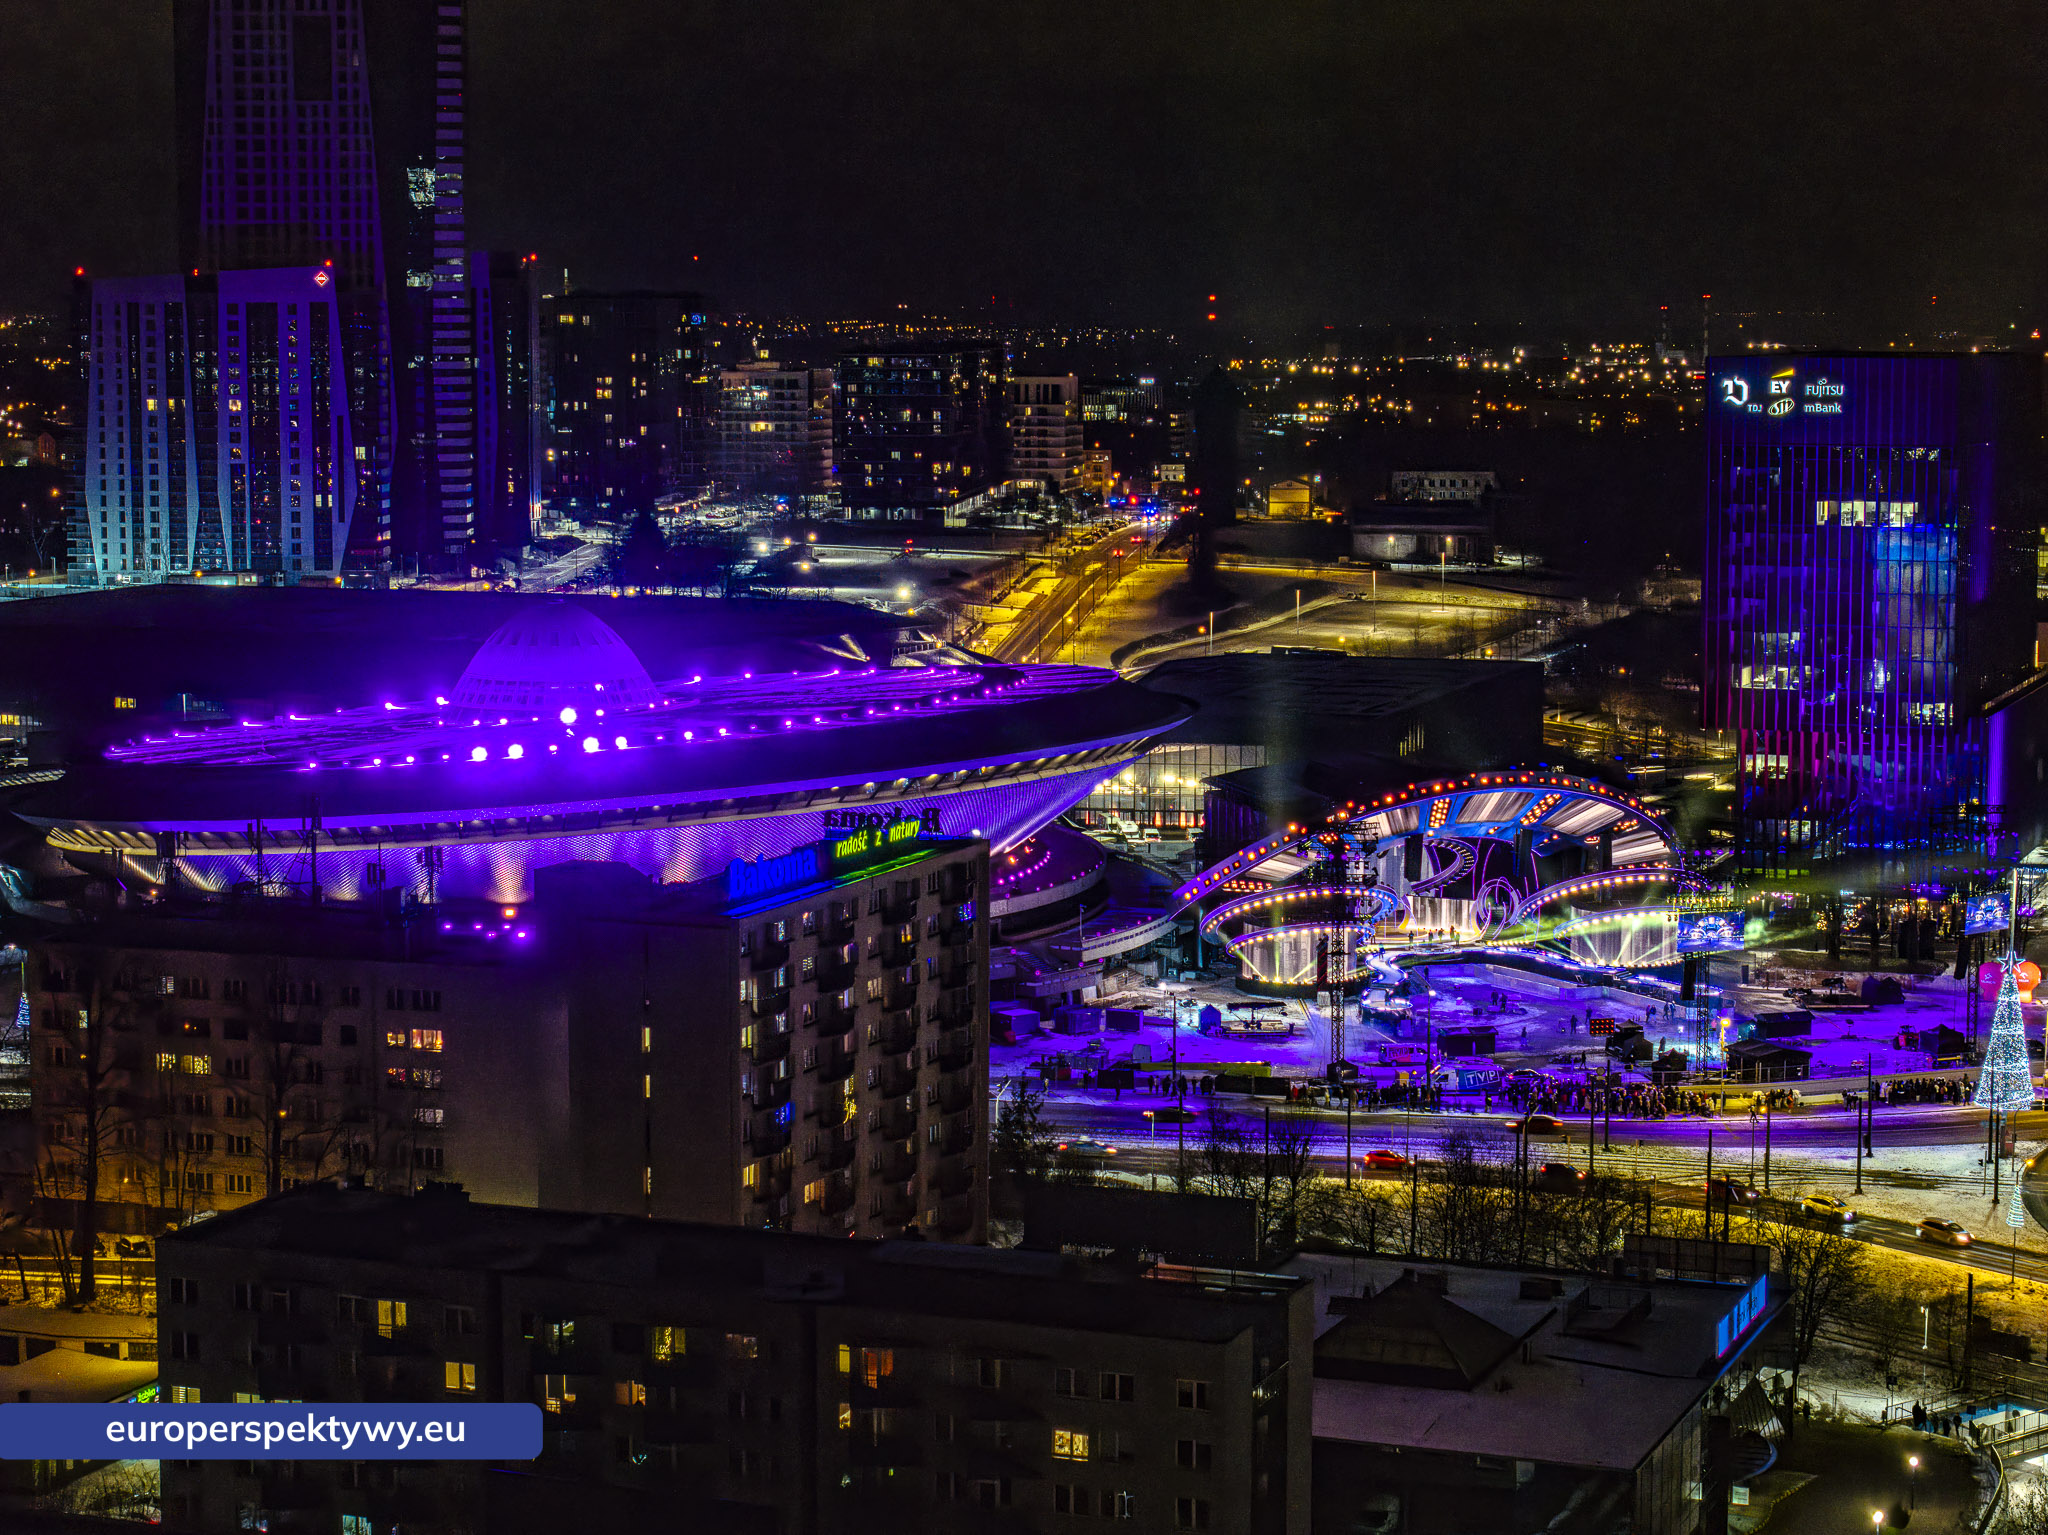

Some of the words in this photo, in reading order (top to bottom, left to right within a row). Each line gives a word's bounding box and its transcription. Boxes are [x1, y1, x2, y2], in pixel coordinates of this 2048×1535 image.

[1770, 380, 1790, 394] EY
[1805, 381, 1845, 398] FUJITSU
[1747, 404, 1763, 413] TDJ
[1804, 403, 1842, 413] mBank
[836, 829, 868, 858] radość
[875, 831, 882, 847] z
[889, 820, 920, 842] natury
[730, 850, 817, 898] Bakoma
